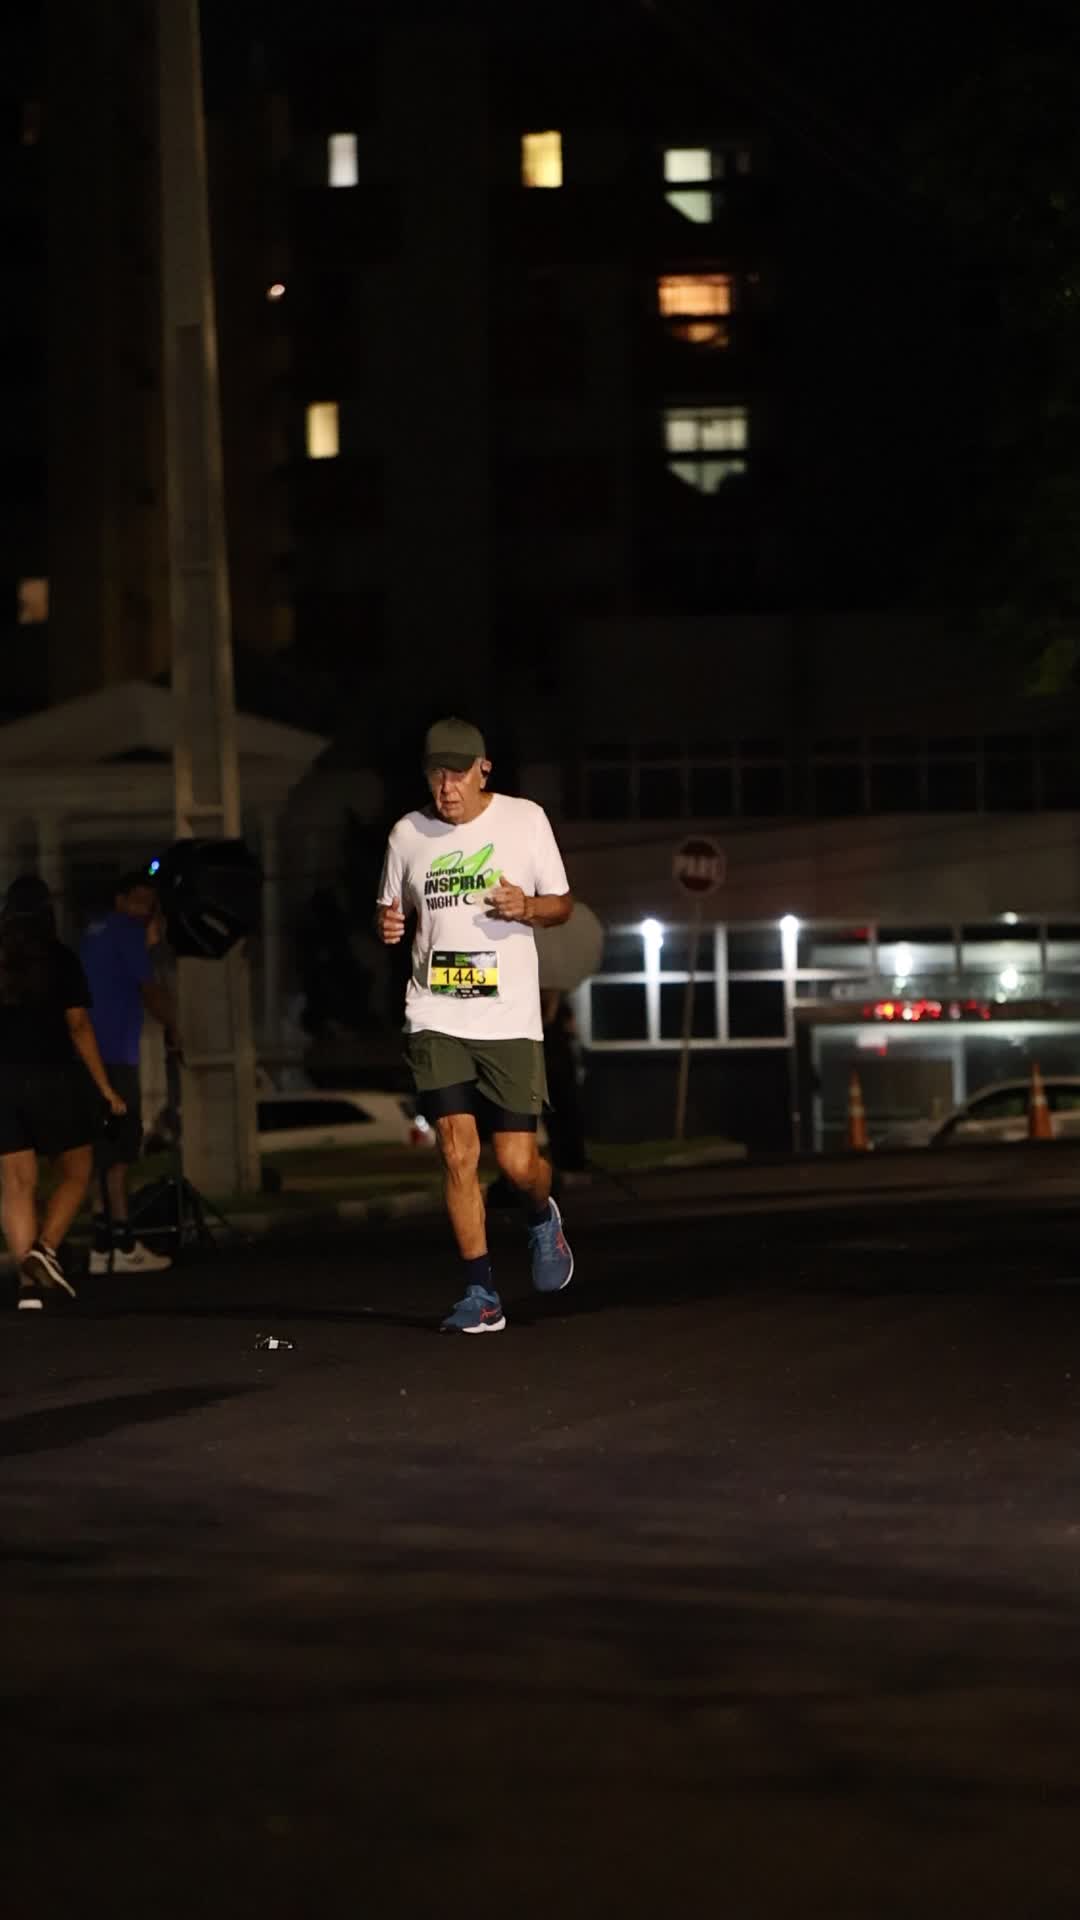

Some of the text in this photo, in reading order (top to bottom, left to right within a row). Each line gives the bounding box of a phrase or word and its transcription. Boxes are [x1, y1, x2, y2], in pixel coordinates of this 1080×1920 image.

[426, 866, 464, 878] Unimed
[424, 874, 486, 896] INSPIRA
[426, 894, 459, 911] NIGHT
[443, 969, 487, 984] 1443
